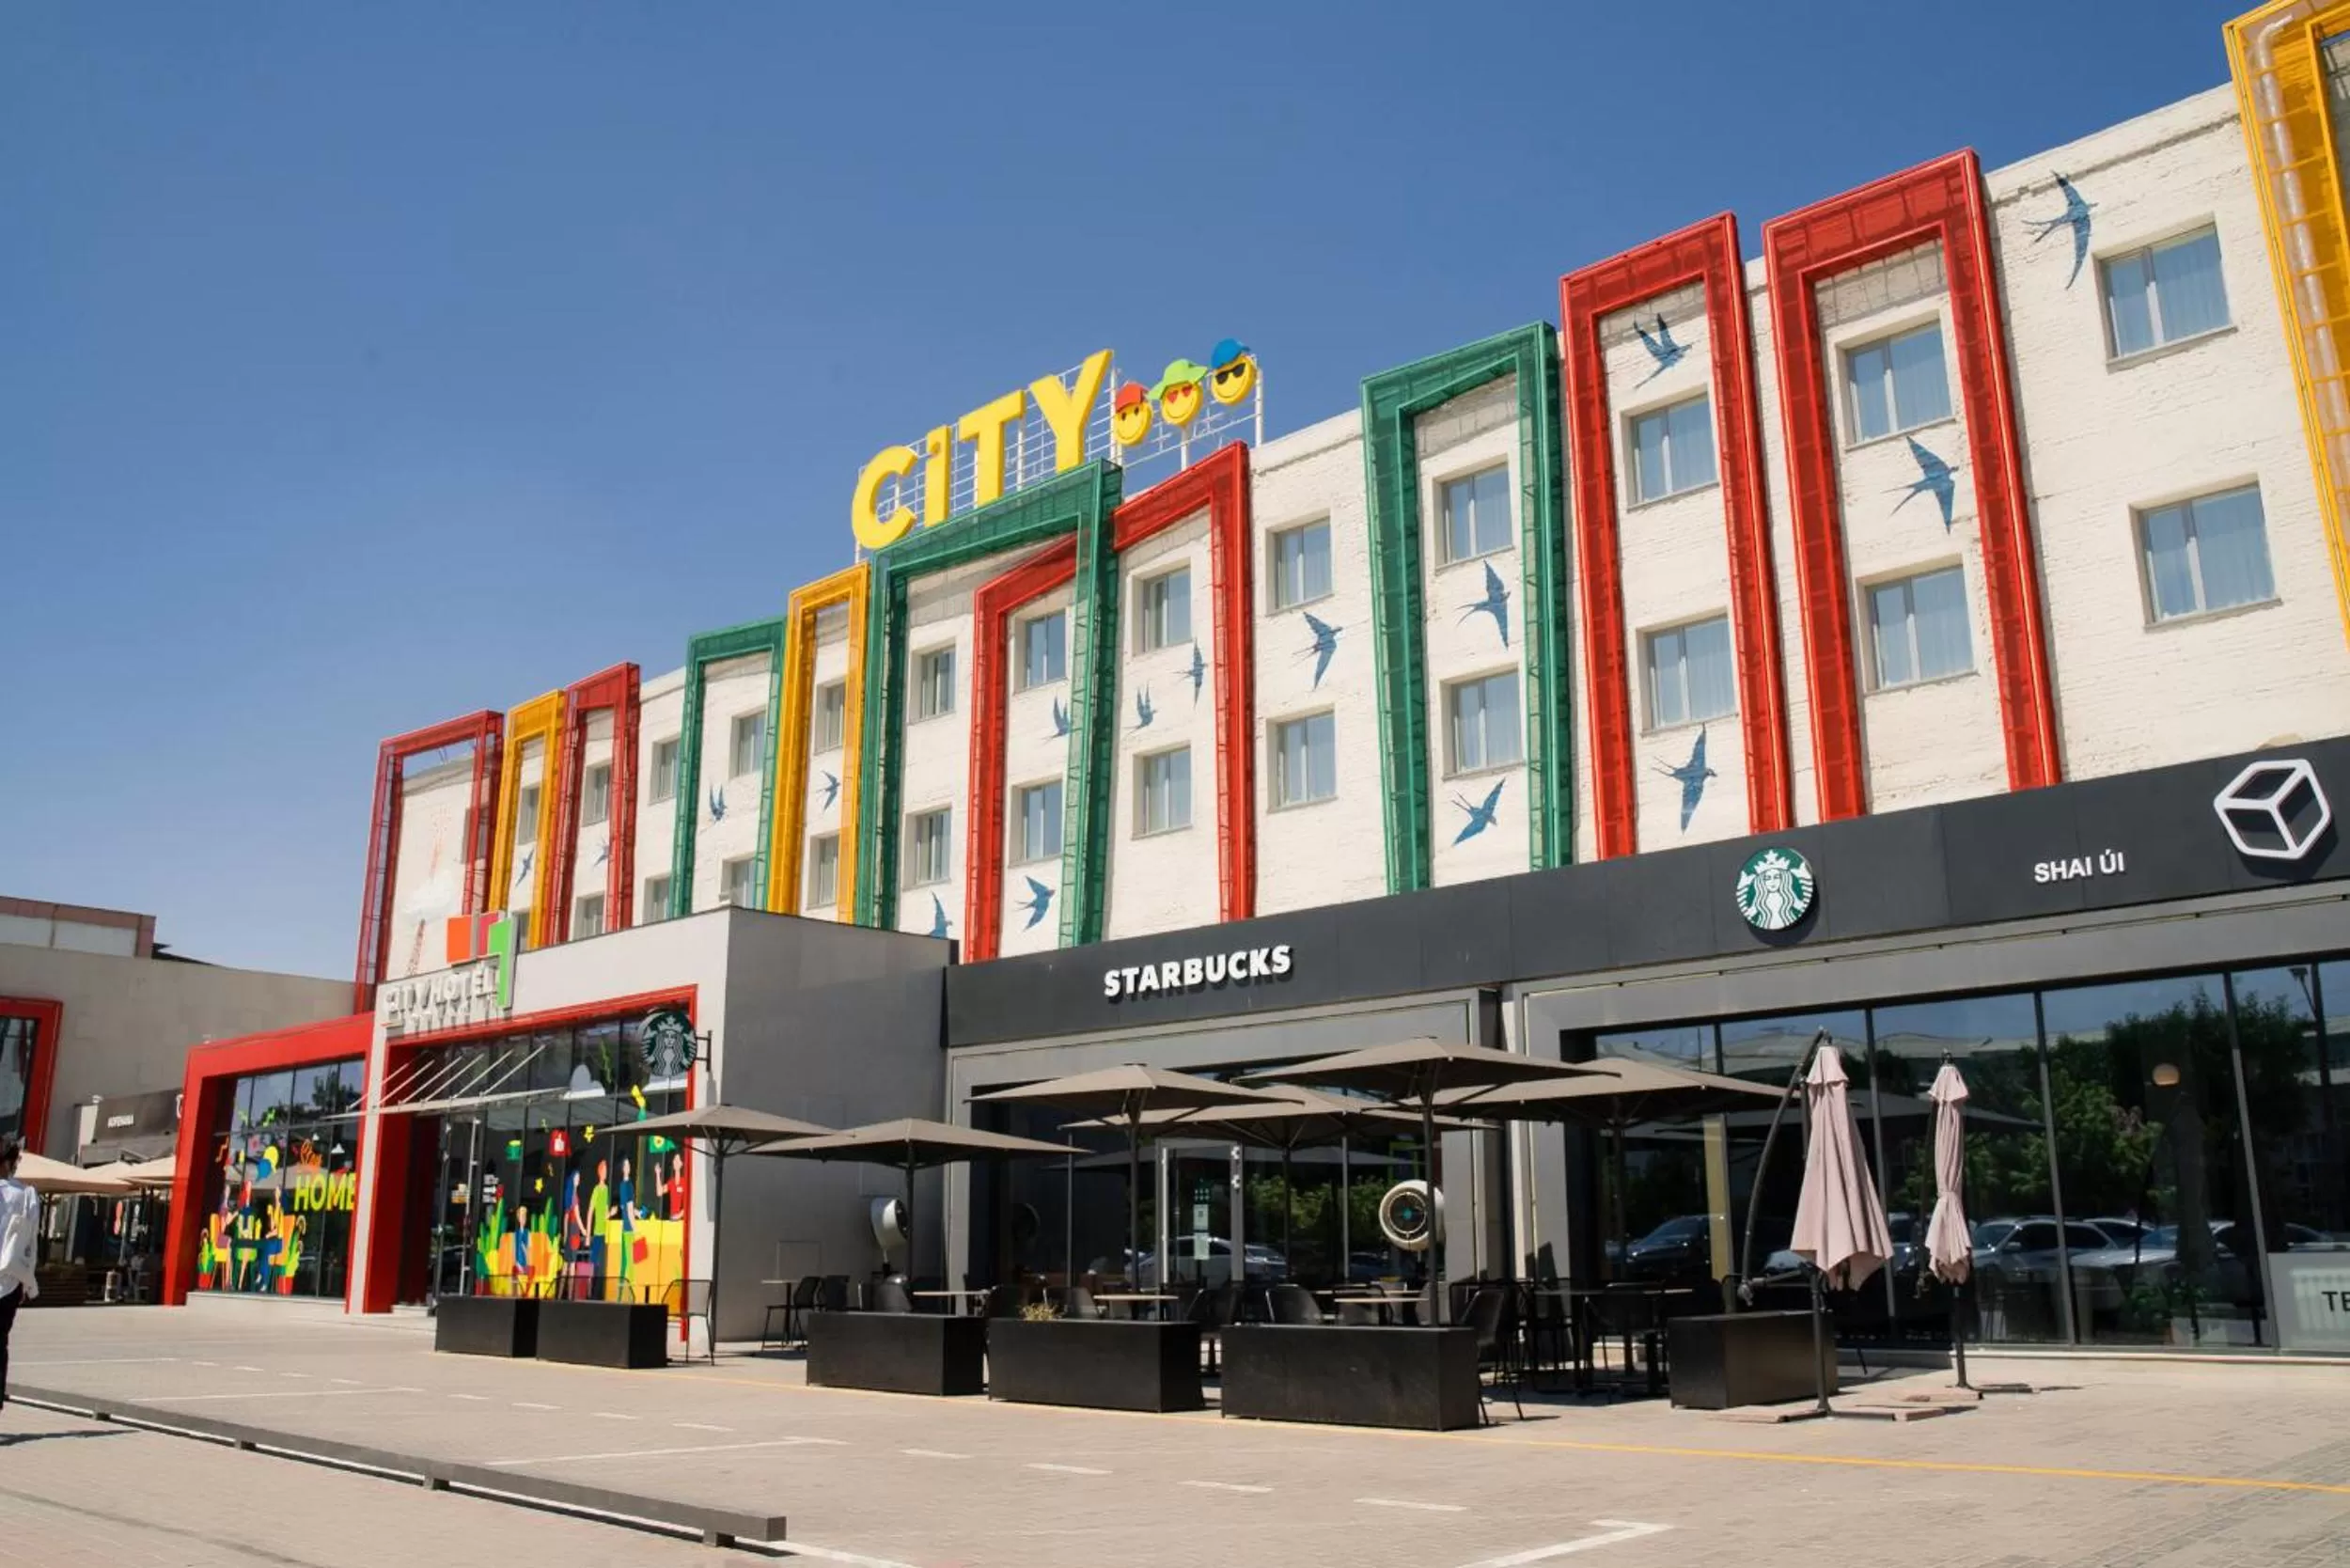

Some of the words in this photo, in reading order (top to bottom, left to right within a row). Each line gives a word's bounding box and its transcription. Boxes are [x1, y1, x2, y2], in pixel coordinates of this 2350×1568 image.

[2034, 855, 2092, 883] SHAI
[2099, 849, 2124, 873] ÚI
[1104, 945, 1292, 997] STARBUCKS
[294, 1172, 356, 1212] HOME
